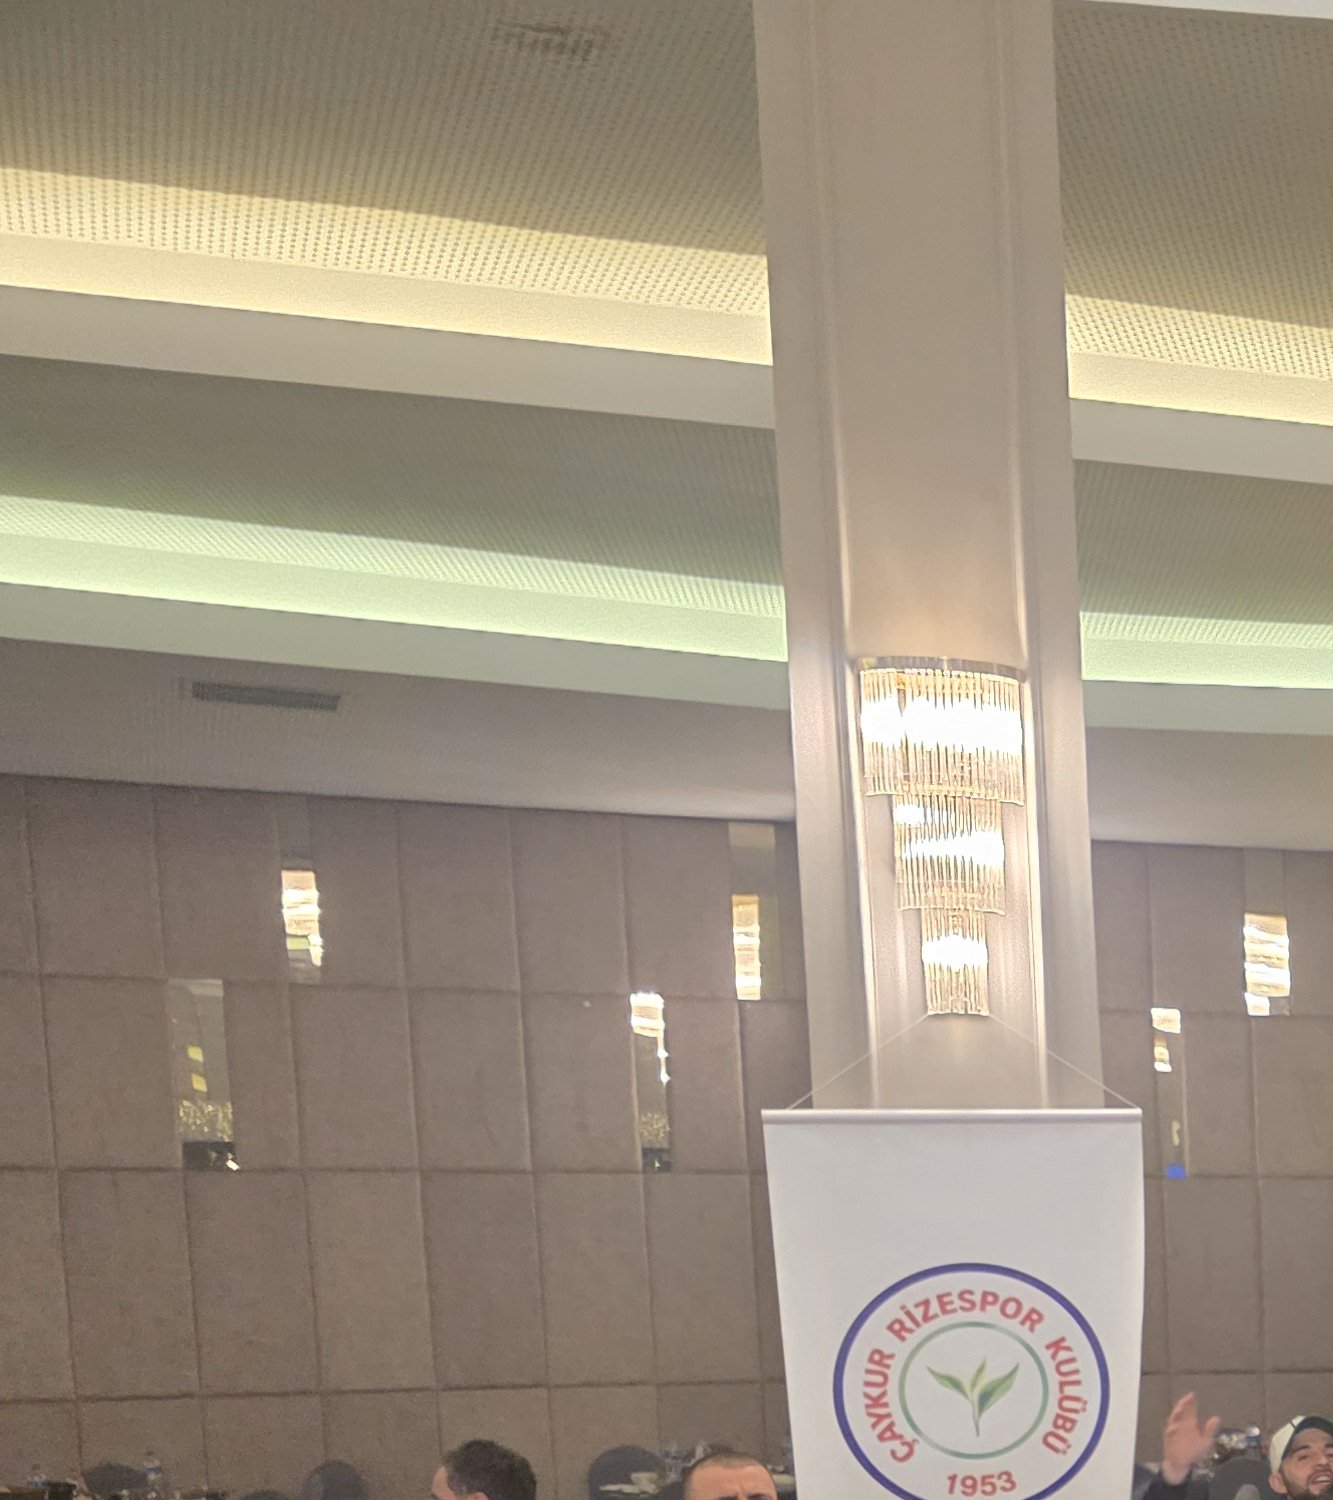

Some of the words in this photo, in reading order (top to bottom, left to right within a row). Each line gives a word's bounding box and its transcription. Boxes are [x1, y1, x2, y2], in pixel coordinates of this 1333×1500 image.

[886, 1289, 1045, 1342] RİZESPOR
[862, 1347, 920, 1464] ÇAYKUR
[1041, 1336, 1088, 1456] KULÜBÜ
[946, 1471, 1017, 1497] 1953
